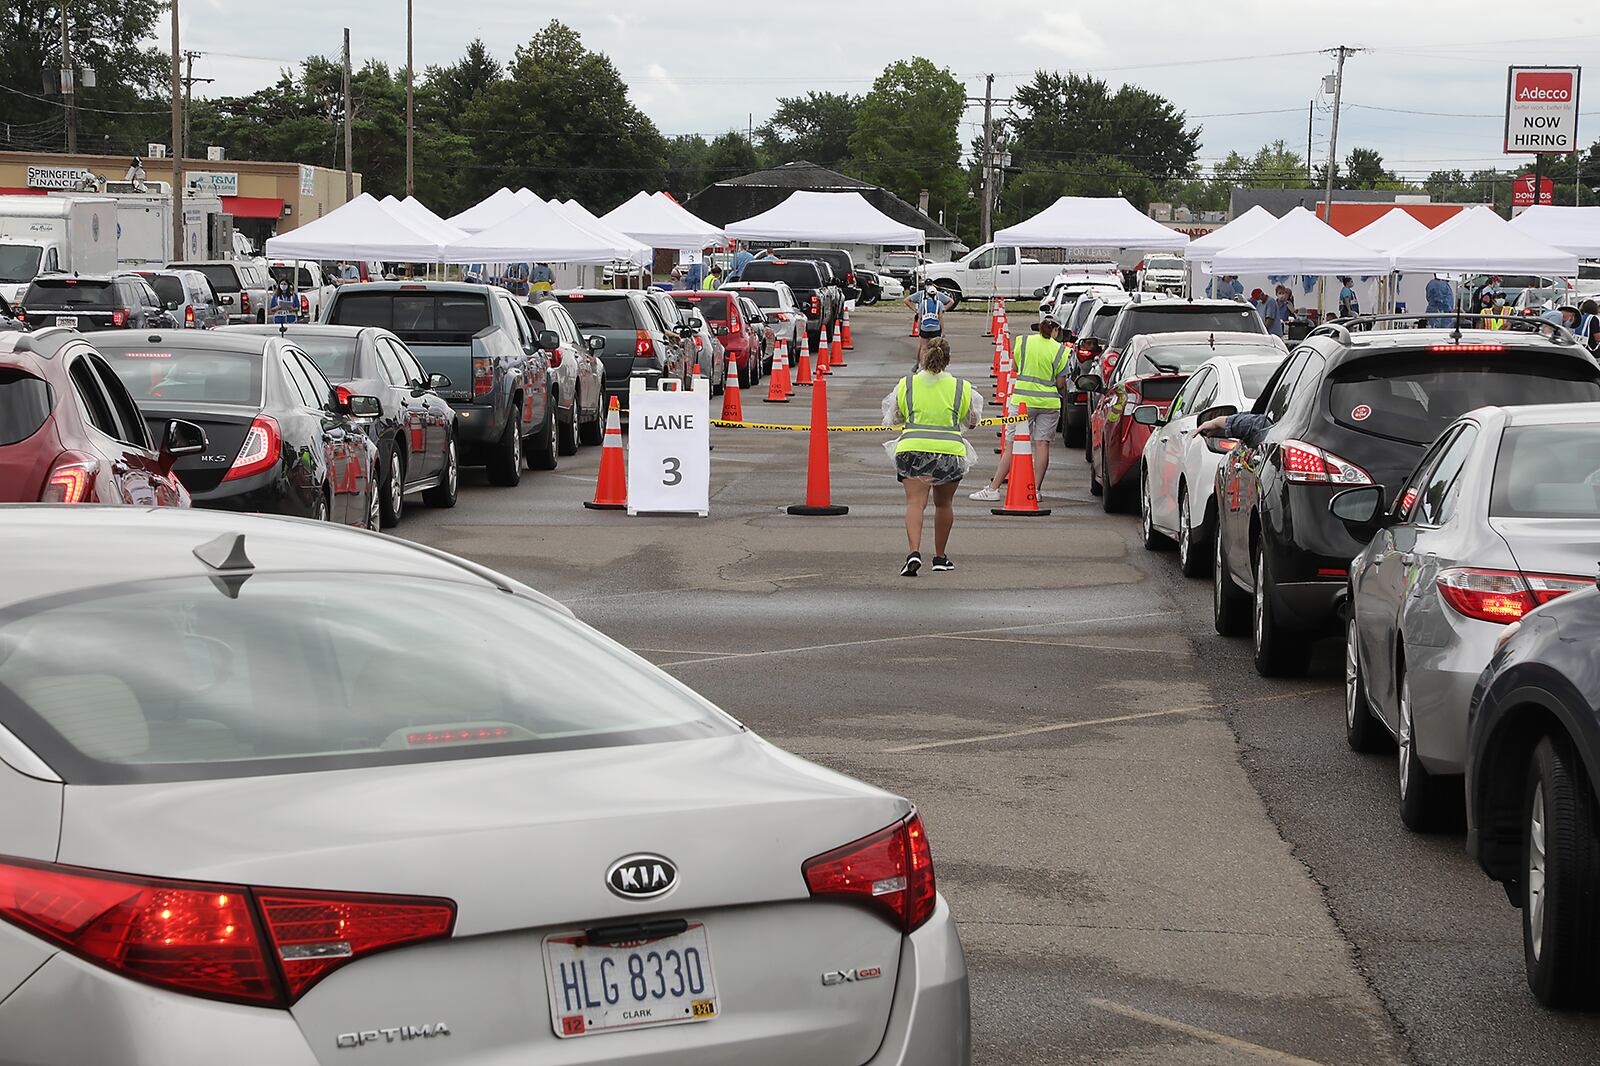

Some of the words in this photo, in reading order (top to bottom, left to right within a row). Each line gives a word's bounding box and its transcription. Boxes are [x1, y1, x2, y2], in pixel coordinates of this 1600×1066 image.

[1520, 87, 1568, 99] Adecco
[1524, 117, 1560, 128] NOW
[1515, 134, 1567, 146] HIRING
[210, 175, 236, 185] T&M
[1068, 248, 1085, 257] FOR
[1086, 248, 1112, 257] LEASE
[644, 414, 694, 430] LANE
[201, 454, 227, 462] MKS
[662, 457, 683, 486] 3
[619, 864, 669, 890] KIA
[560, 957, 620, 1011] HLG
[628, 947, 705, 1001] 8330
[822, 969, 854, 986] EX
[859, 966, 881, 978] GDI
[622, 1009, 652, 1020] CLARK
[565, 1019, 582, 1033] 12
[336, 1022, 451, 1048] OPTIMA
